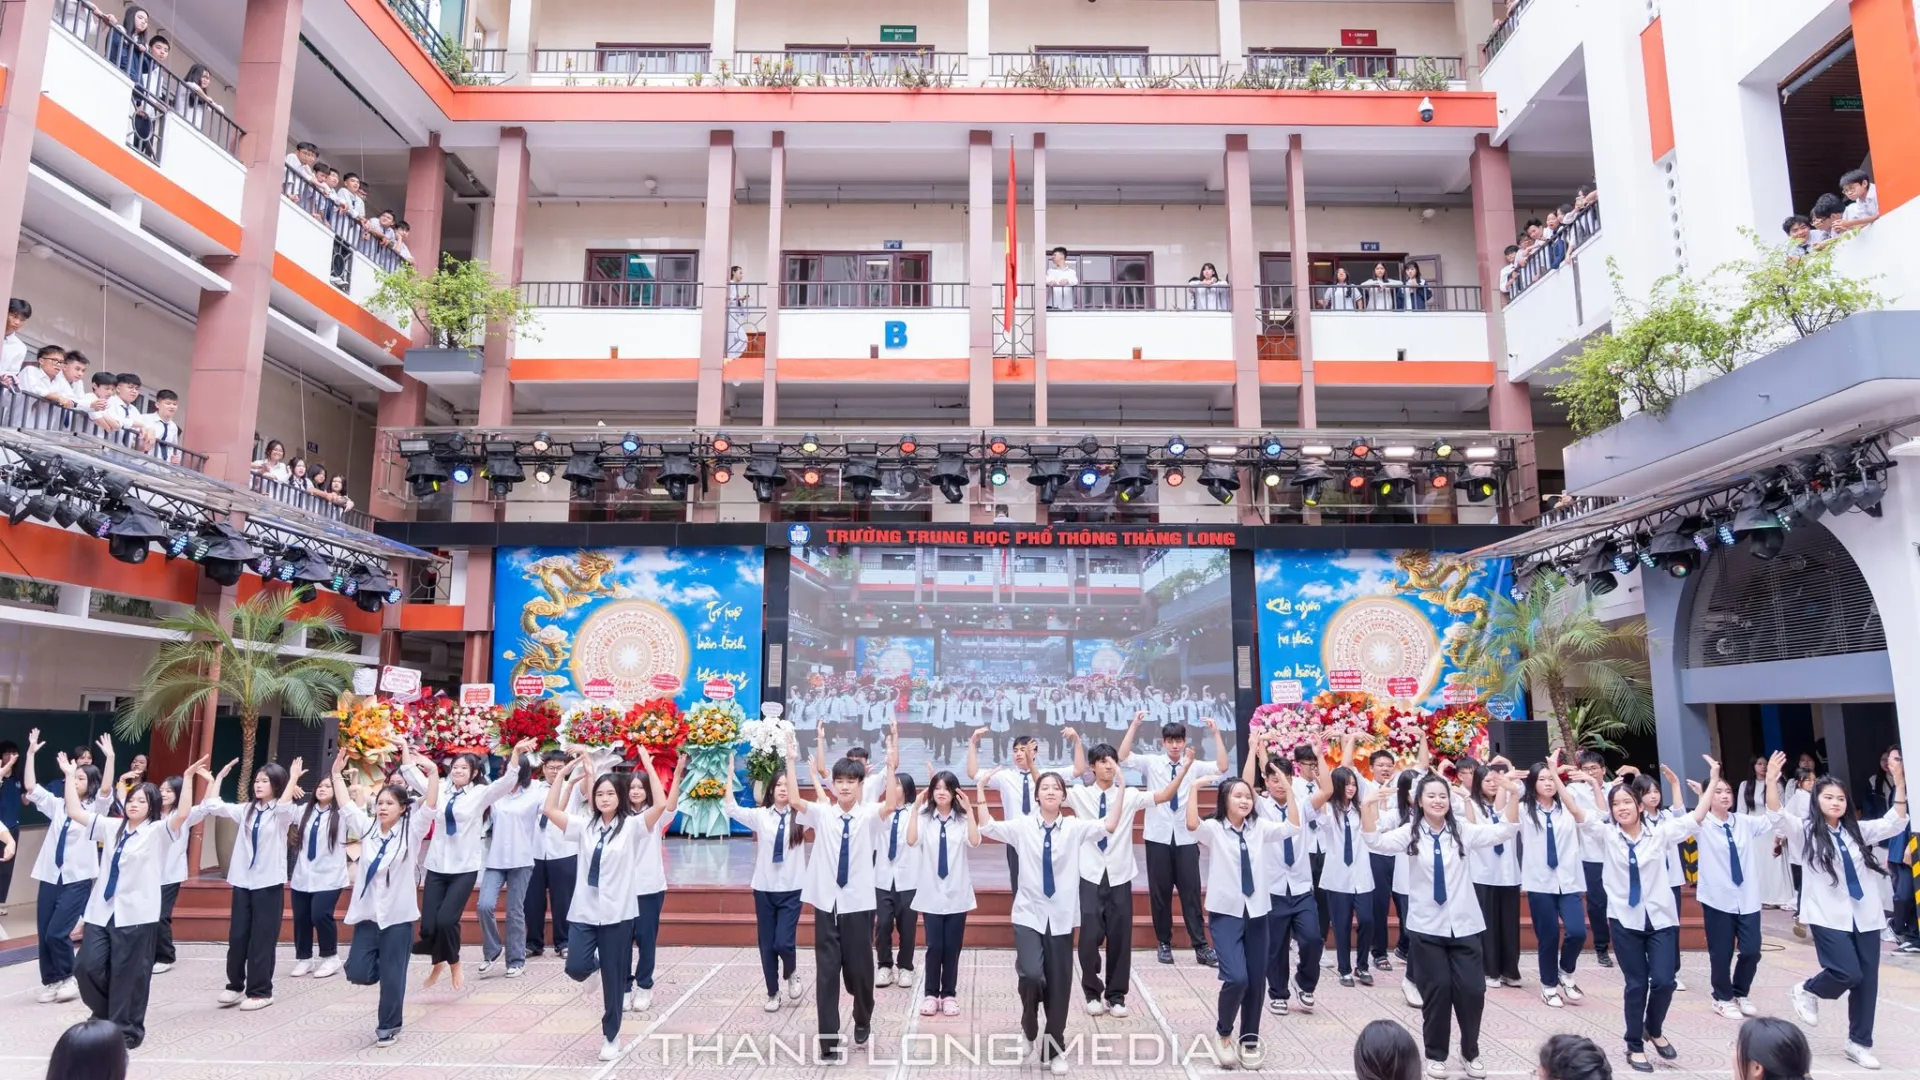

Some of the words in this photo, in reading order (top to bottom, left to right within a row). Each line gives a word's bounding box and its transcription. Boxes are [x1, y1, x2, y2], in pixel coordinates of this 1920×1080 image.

[884, 321, 908, 349] B
[826, 526, 902, 544] TRƯỜNG
[907, 530, 968, 544] TRUNG
[973, 531, 1011, 547] HỌC
[1015, 525, 1054, 545] PHỔ
[1057, 528, 1118, 545] THÔNG
[1122, 528, 1182, 546] THĂNG
[1187, 532, 1236, 546] LONG
